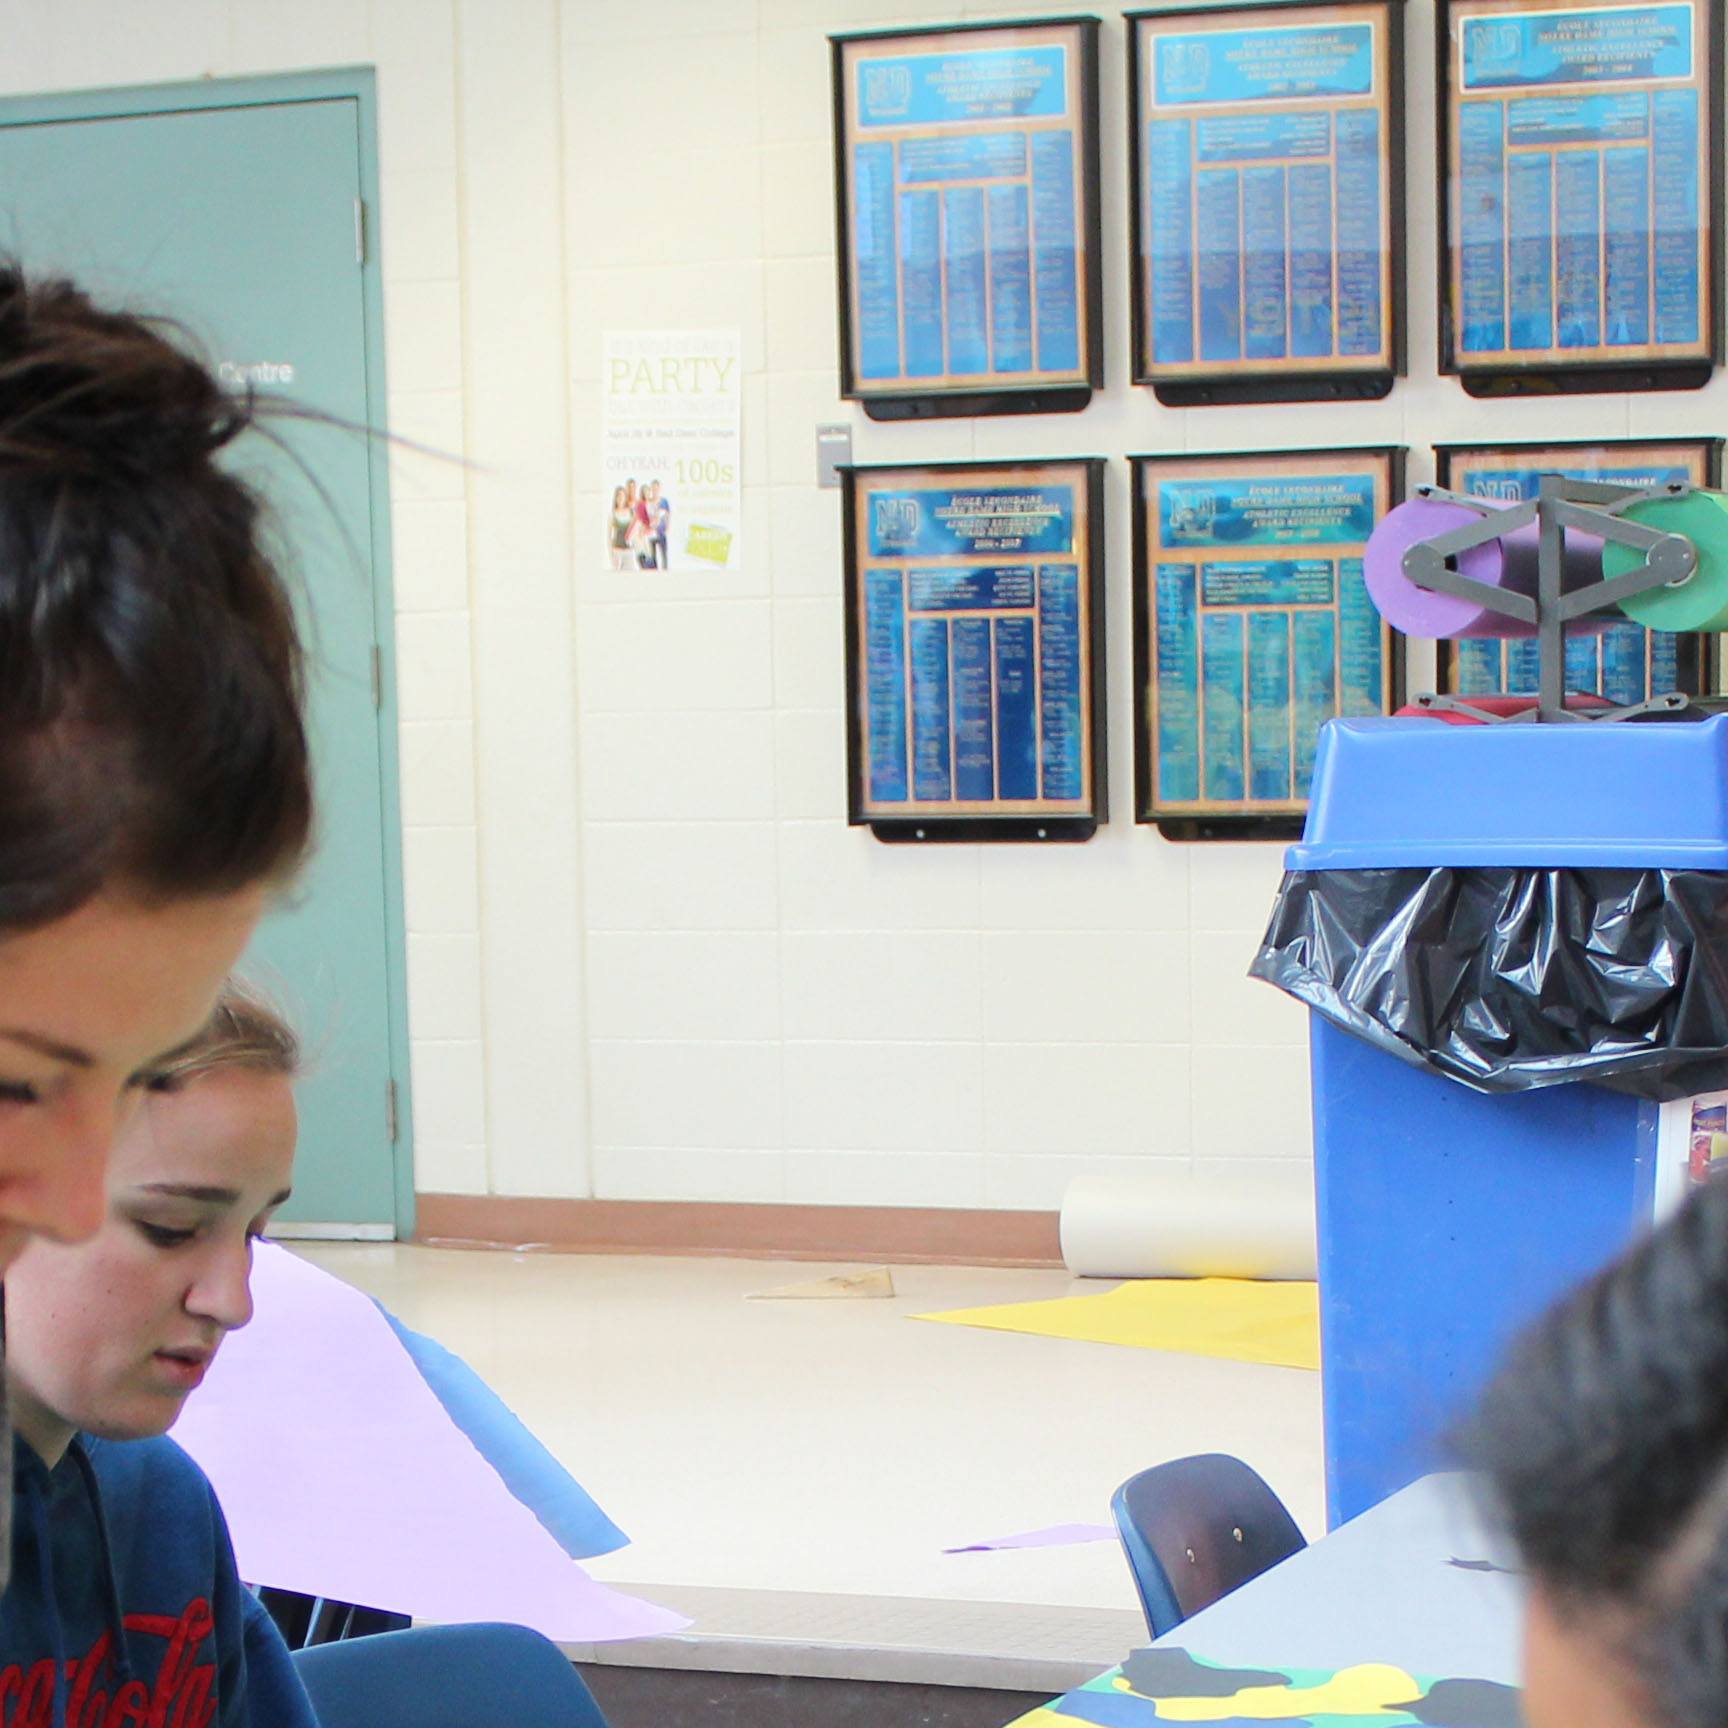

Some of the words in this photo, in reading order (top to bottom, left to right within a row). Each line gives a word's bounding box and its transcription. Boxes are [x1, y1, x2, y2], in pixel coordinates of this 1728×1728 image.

[218, 361, 295, 384] Centre
[608, 357, 736, 394] PARTY
[675, 458, 735, 485] 100s
